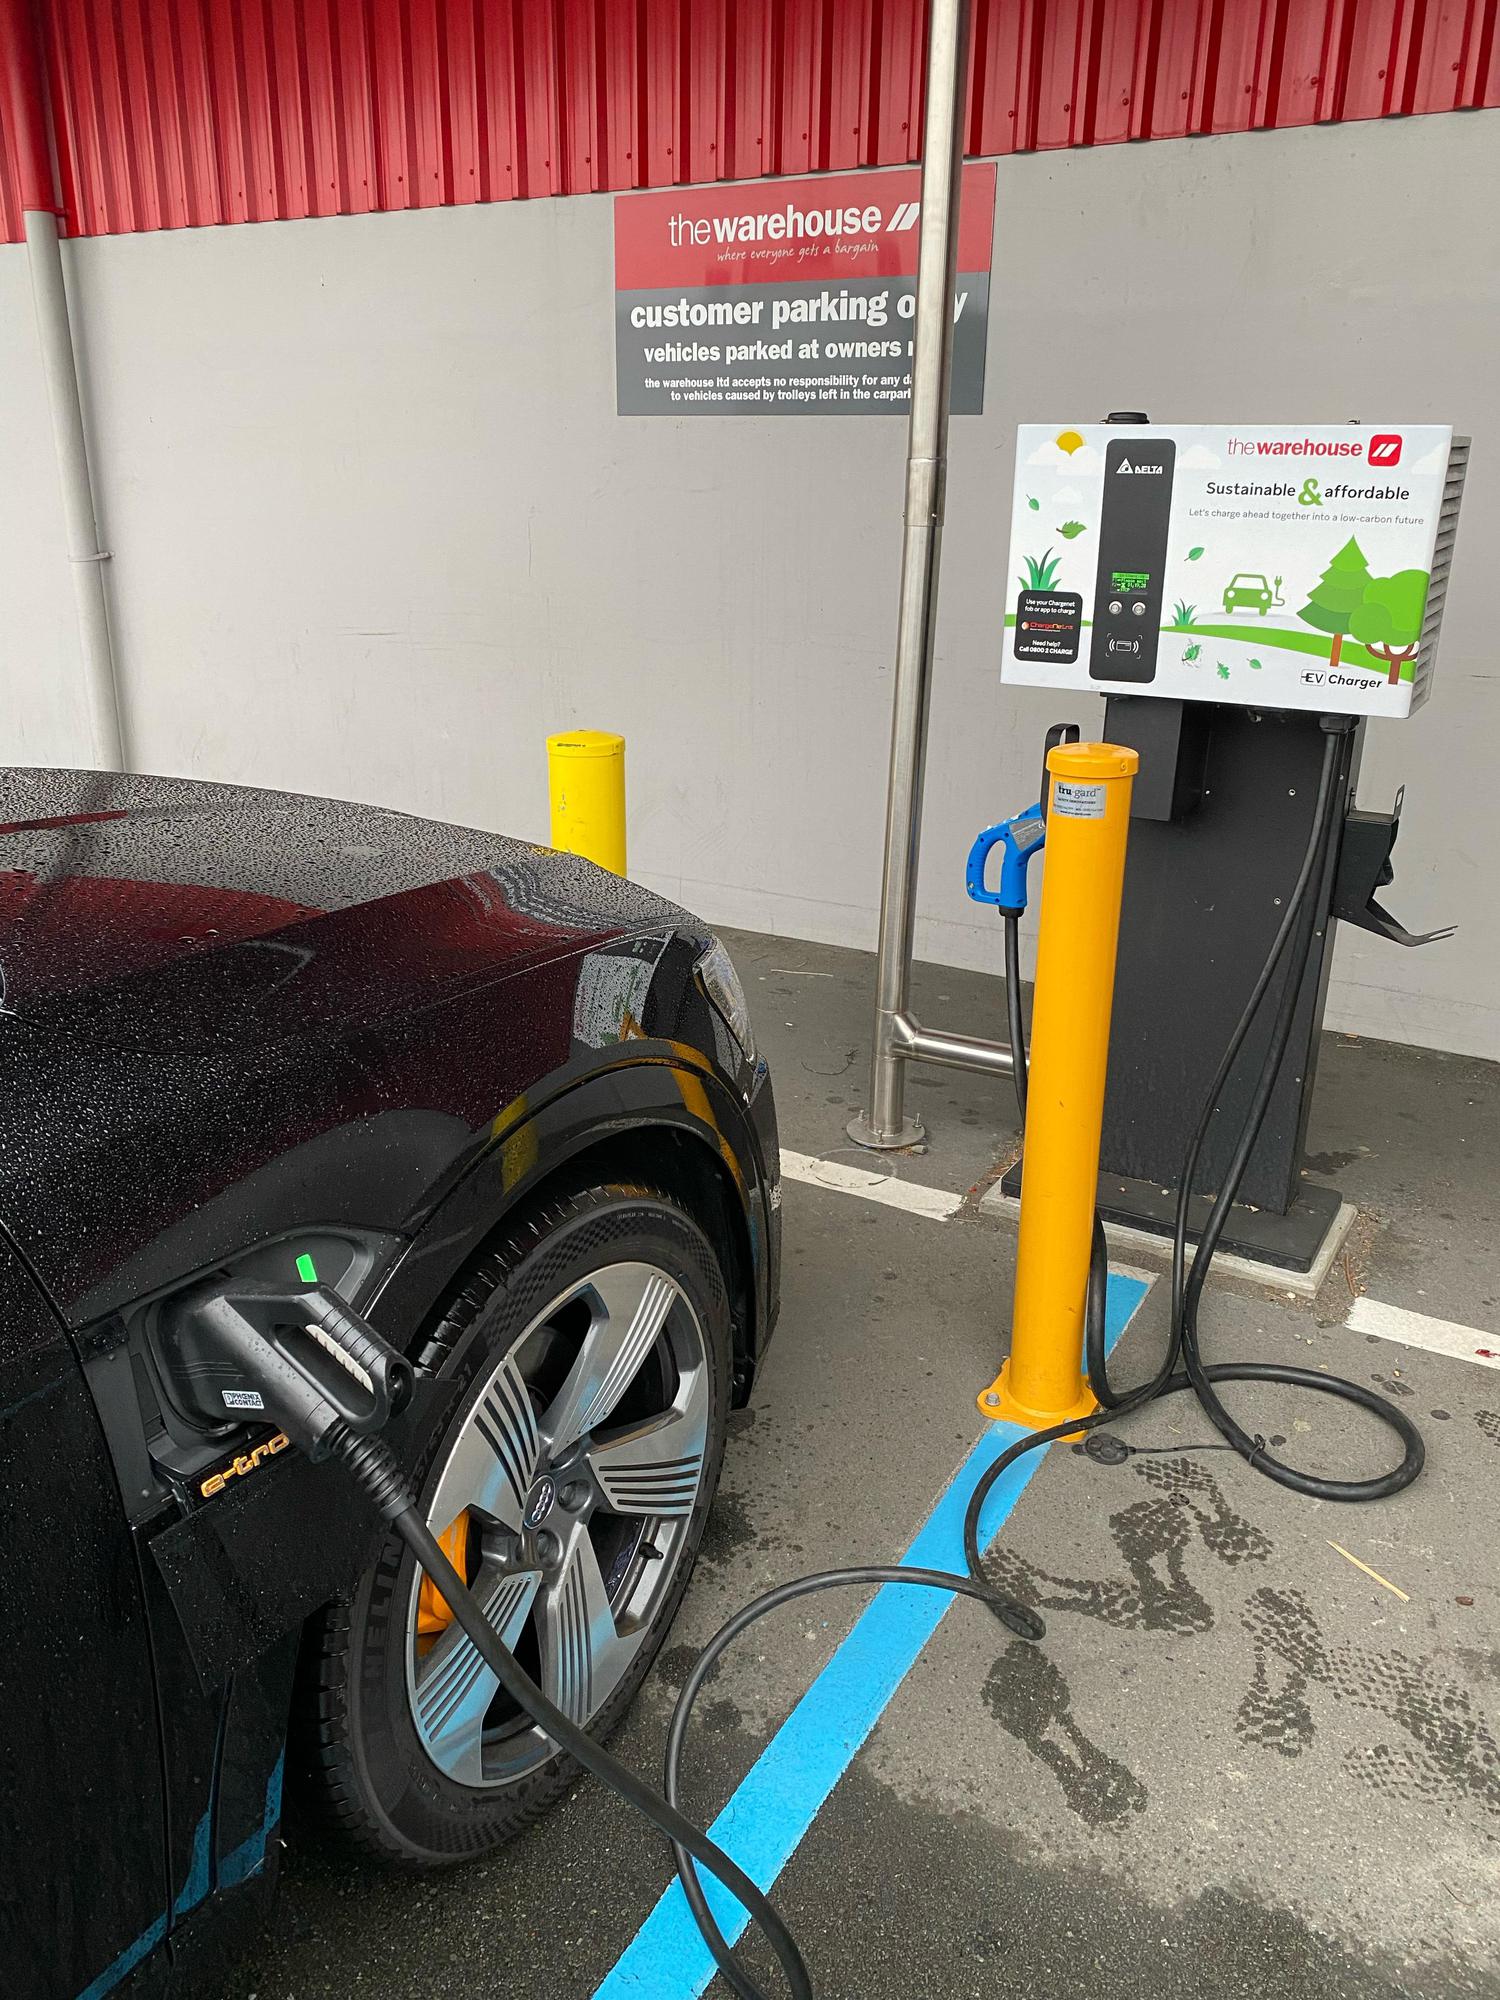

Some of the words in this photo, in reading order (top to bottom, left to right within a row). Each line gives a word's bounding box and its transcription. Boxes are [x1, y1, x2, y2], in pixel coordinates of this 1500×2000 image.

[716, 246, 747, 262] where
[750, 247, 794, 265] everyone
[798, 244, 818, 263] gets
[823, 246, 831, 254] a
[834, 238, 879, 260] bargain
[630, 298, 764, 328] customer
[772, 290, 889, 329] parking
[896, 291, 968, 324] oy
[643, 342, 721, 362] vehicles
[725, 339, 793, 365] parked
[798, 338, 820, 359] at
[824, 340, 902, 359] owners
[644, 377, 660, 388] the
[662, 377, 714, 388] warehouse
[716, 376, 730, 387] ltd
[731, 376, 771, 389] accepts
[773, 377, 786, 387] no
[788, 374, 860, 388] responsibility
[862, 374, 878, 385] for
[880, 375, 900, 387] any
[670, 390, 681, 401] to
[683, 390, 723, 401] vehicles
[725, 389, 761, 400] caused
[763, 389, 775, 402] by
[777, 389, 817, 402] trolleys
[819, 388, 838, 400] left
[840, 388, 850, 399] in
[853, 388, 871, 399] the
[1134, 465, 1163, 474] DELTA
[1206, 481, 1296, 497] Sustainable
[1297, 478, 1324, 506] &
[1324, 484, 1410, 500] affordable
[1189, 508, 1210, 517] Let's
[1211, 509, 1240, 519] charge
[1242, 510, 1270, 519] ahead
[1271, 511, 1310, 521] together
[1312, 512, 1330, 521] into
[1340, 513, 1392, 524] low-carbon
[1395, 515, 1424, 525] future
[1304, 672, 1324, 684] EV
[1328, 674, 1383, 690] Charger
